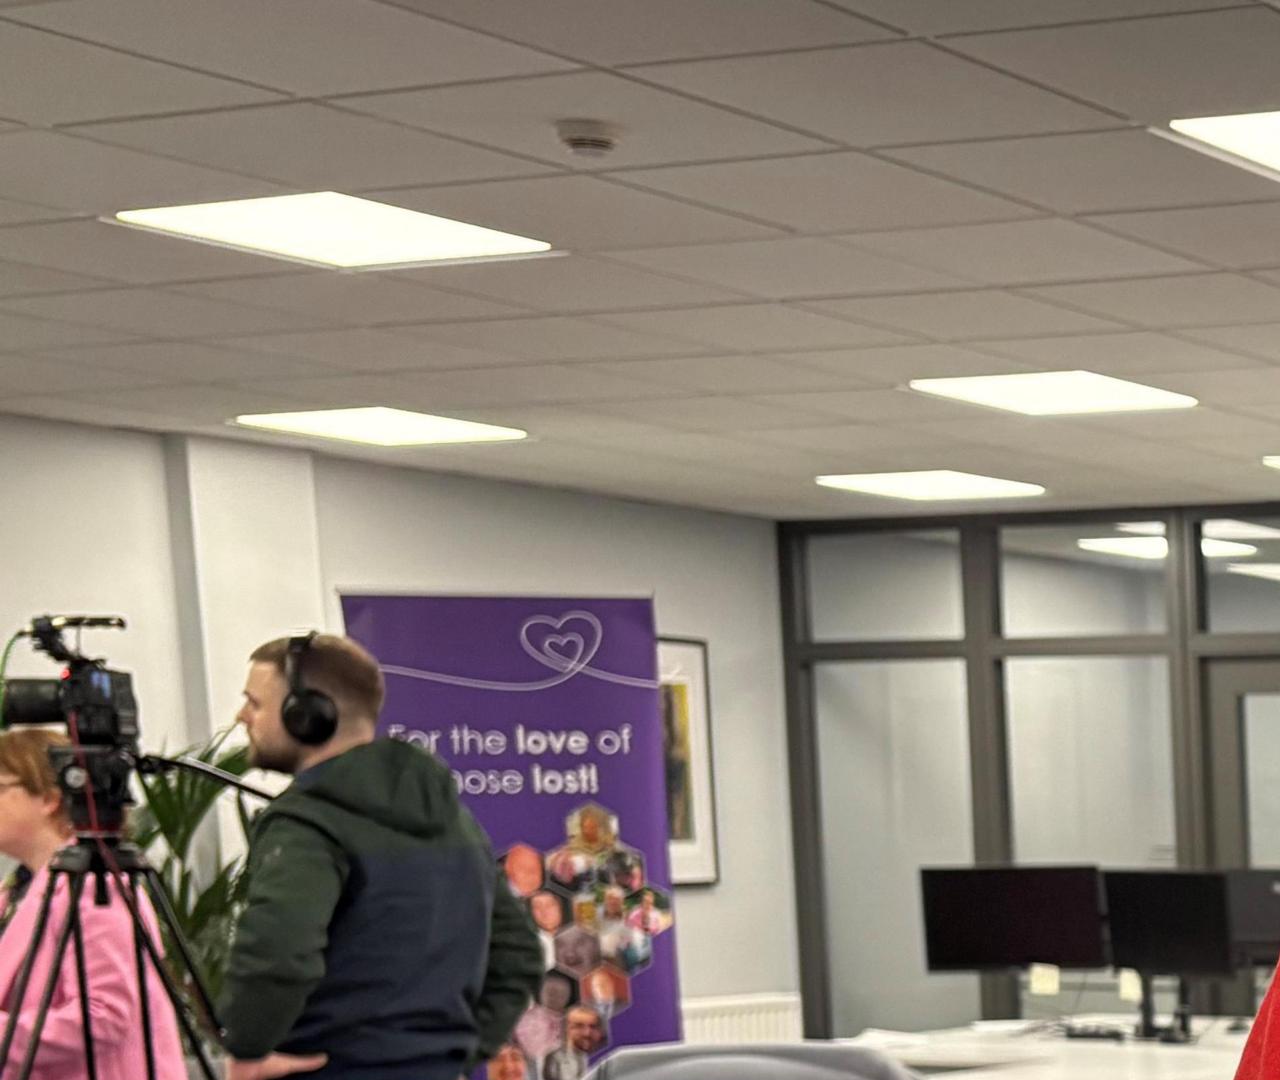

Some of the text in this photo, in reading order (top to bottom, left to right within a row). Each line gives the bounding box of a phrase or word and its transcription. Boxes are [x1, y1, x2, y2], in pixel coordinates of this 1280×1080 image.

[450, 723, 508, 756] the
[516, 723, 590, 756] love
[597, 722, 632, 756] of
[452, 762, 599, 795] ose lost!
